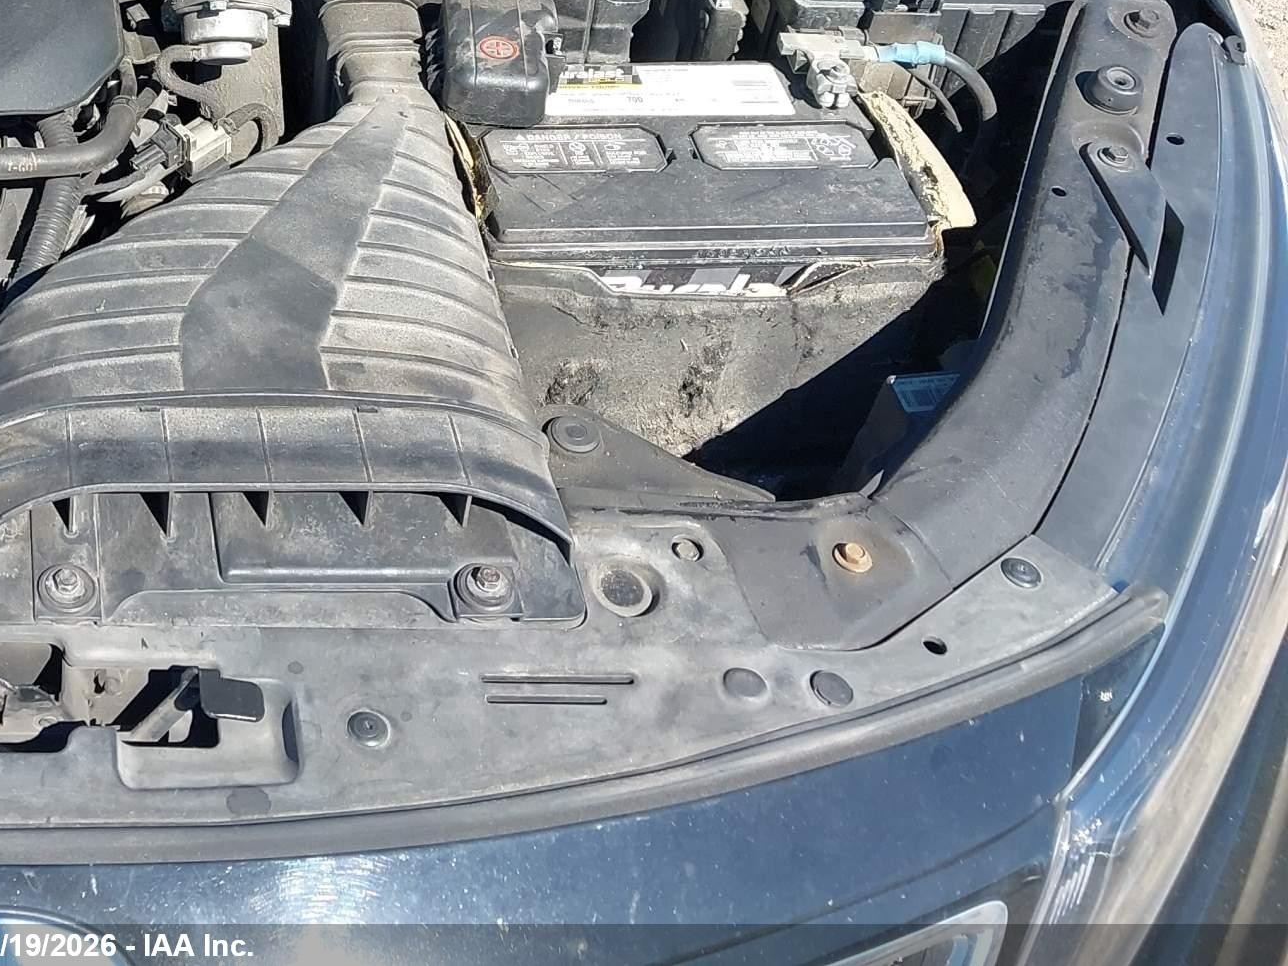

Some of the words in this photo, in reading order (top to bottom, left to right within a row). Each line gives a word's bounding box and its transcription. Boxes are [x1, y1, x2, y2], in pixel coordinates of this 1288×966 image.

[559, 68, 625, 80] uralast
[526, 133, 571, 141] DANGER
[582, 132, 623, 141] POISON
